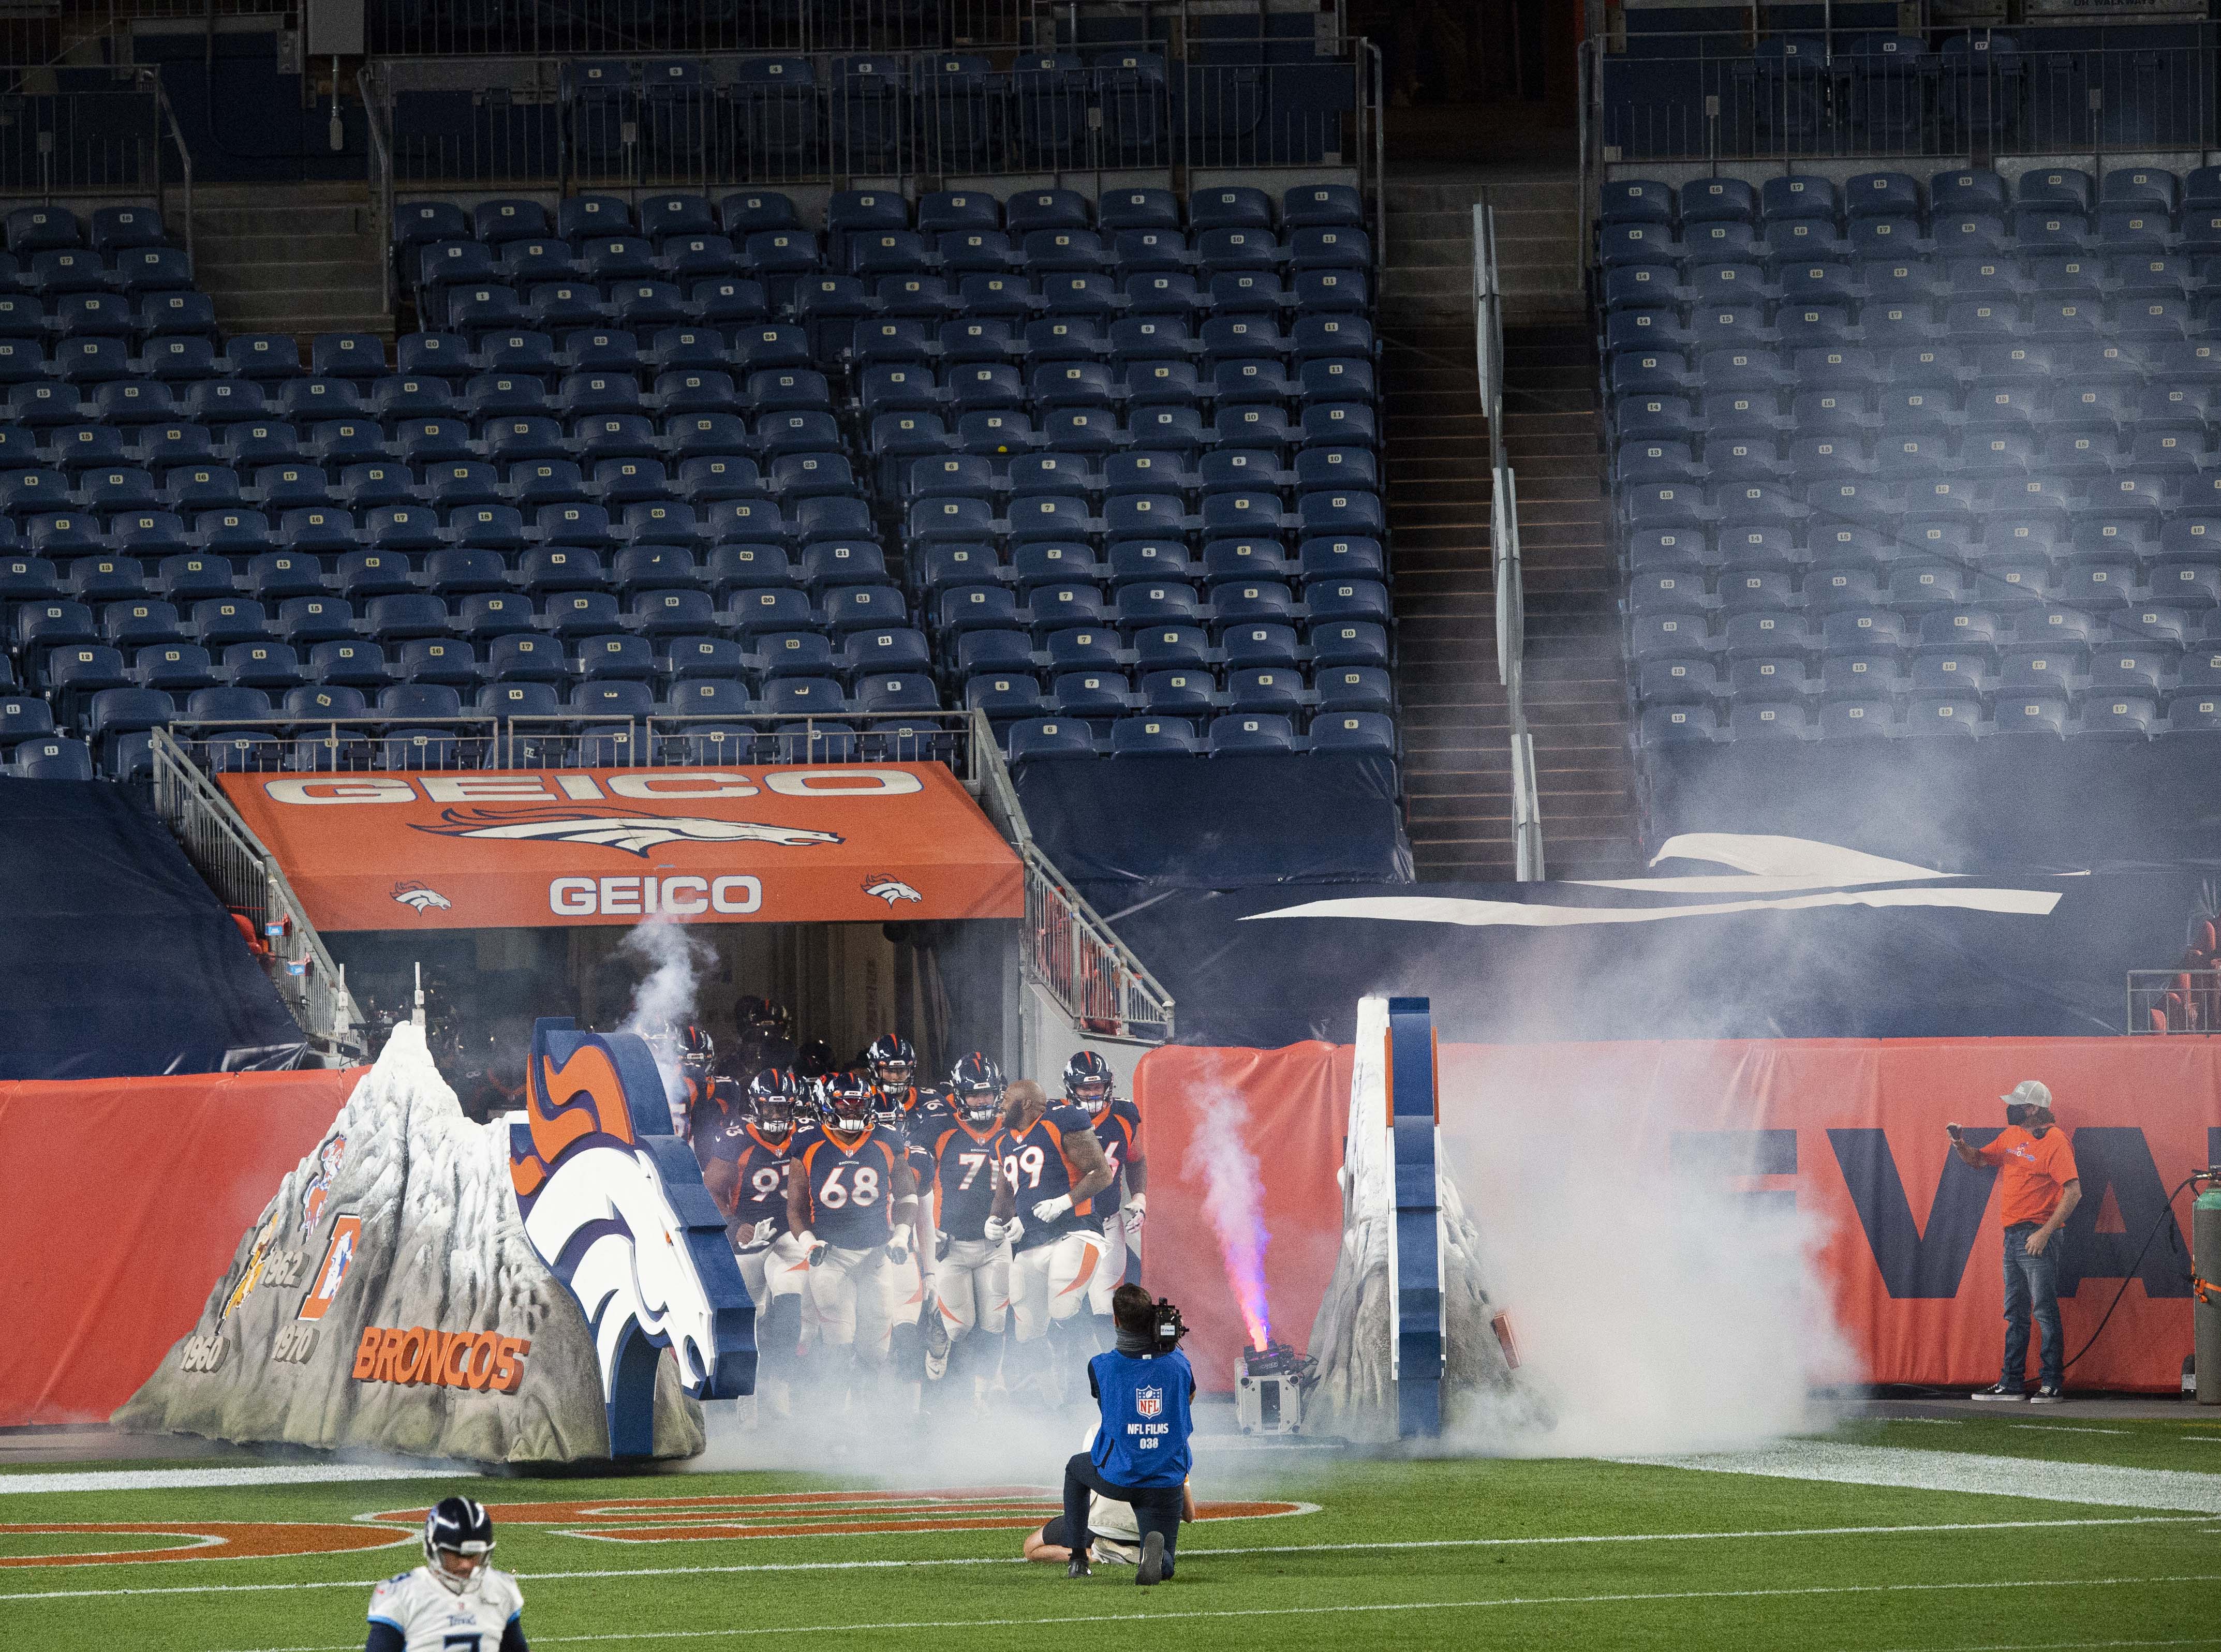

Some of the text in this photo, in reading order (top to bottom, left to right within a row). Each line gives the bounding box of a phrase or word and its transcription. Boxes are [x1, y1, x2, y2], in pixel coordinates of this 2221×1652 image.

[264, 770, 923, 804] GEICO
[550, 874, 762, 916] GEICO
[819, 1167, 879, 1209] 68
[1003, 1145, 1044, 1196] 99
[262, 1251, 303, 1287] 1962
[182, 1335, 224, 1373] 1960
[274, 1325, 310, 1363] 1970
[353, 1326, 531, 1392] BRONCOS
[1139, 1400, 1159, 1413] NFL
[1128, 1423, 1168, 1435] NFL FILMS
[1139, 1438, 1159, 1449] 038
